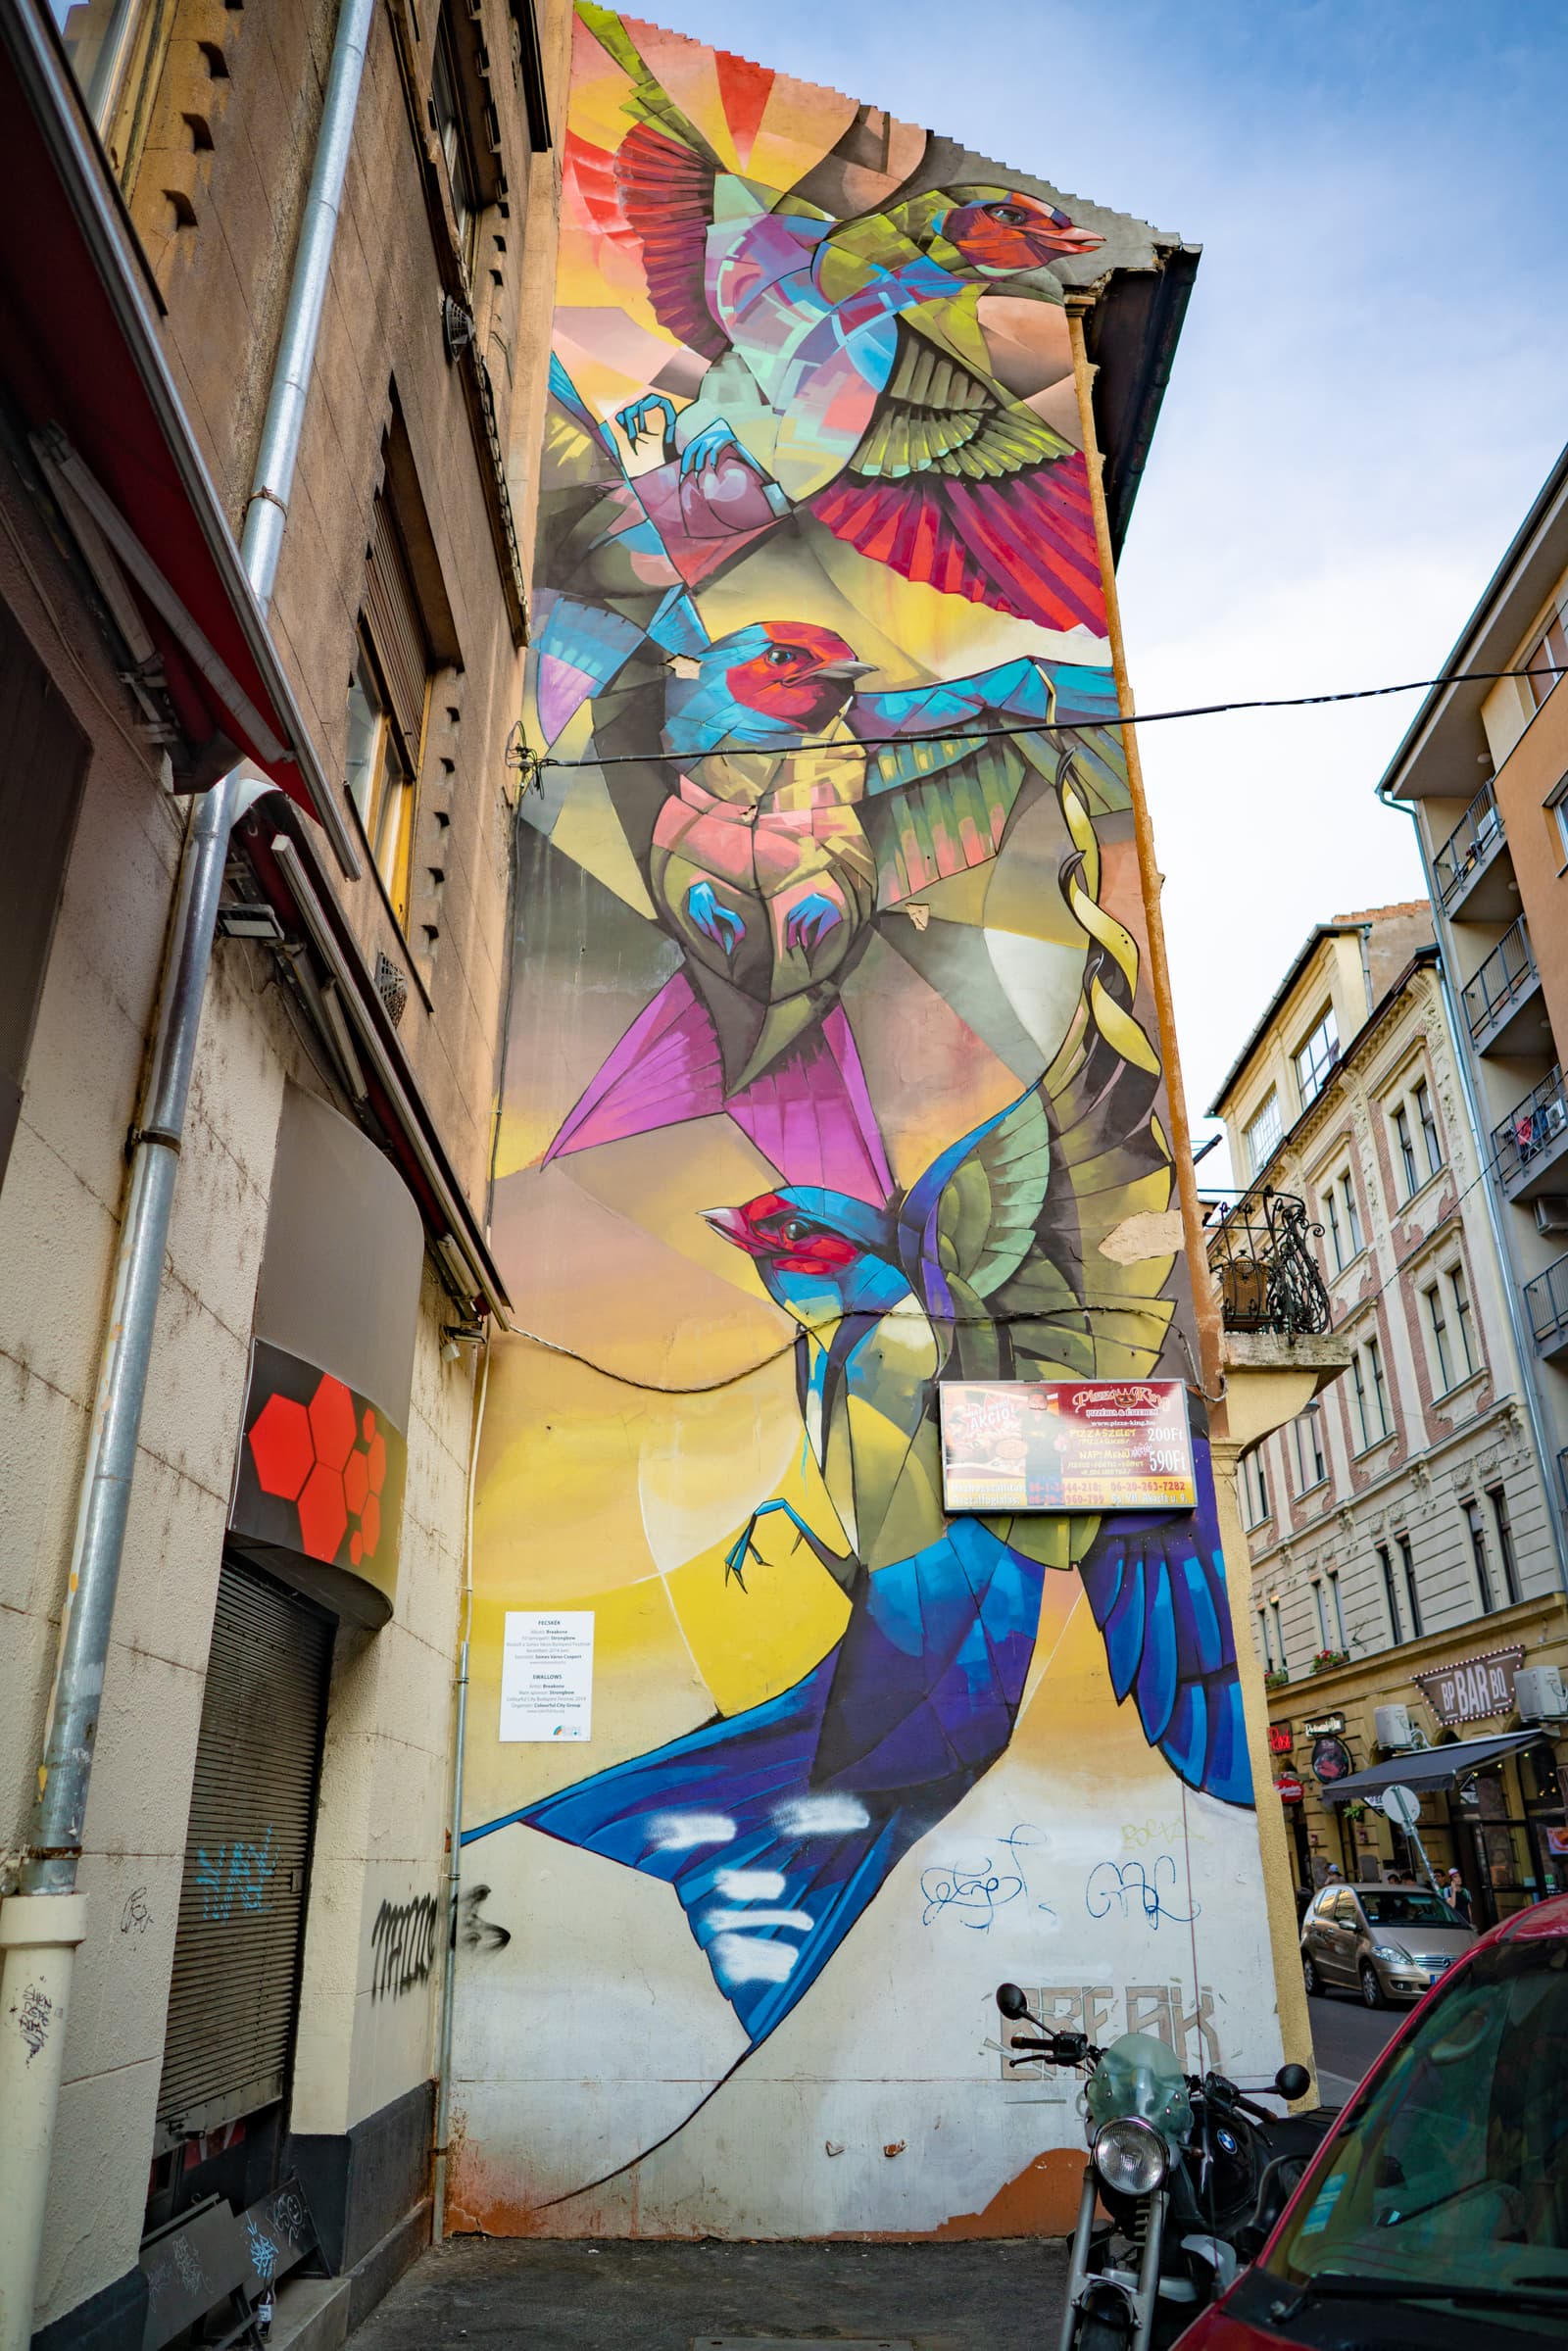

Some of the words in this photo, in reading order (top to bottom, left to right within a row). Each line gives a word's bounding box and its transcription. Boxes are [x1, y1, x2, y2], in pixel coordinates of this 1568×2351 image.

[1148, 1428, 1184, 1443] 200Ft
[1150, 1449, 1186, 1472] 590Ft
[1441, 1681, 1455, 1711] BP
[1454, 1664, 1492, 1716] BAR
[1489, 1666, 1508, 1699] BQ
